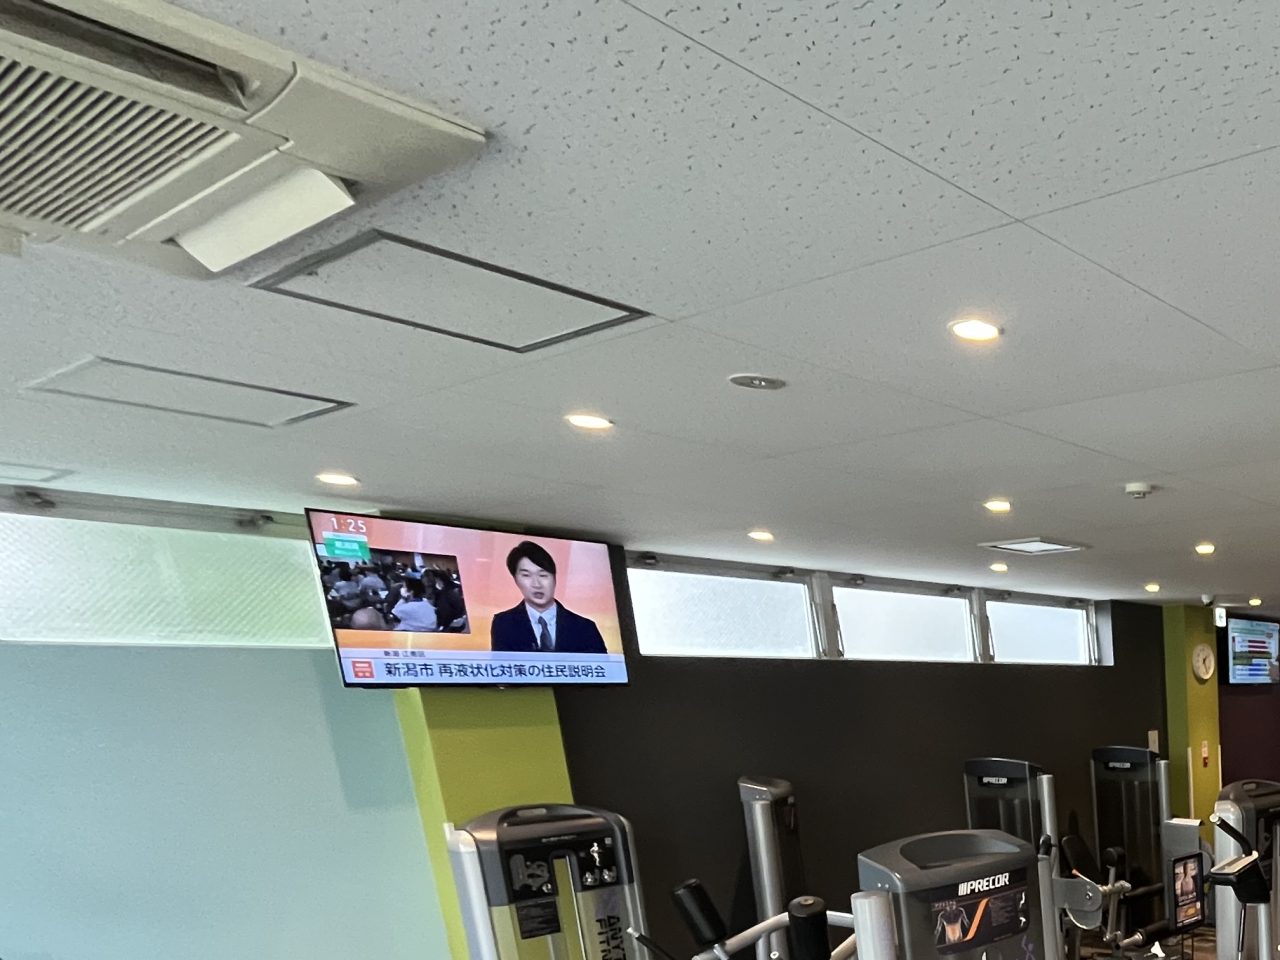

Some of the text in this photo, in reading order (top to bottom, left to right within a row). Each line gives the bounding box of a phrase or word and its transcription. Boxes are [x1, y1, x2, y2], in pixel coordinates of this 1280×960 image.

[330, 517, 367, 533] 1:25
[384, 662, 434, 677] 新潟市
[437, 663, 606, 678] 再液状化対策の住民説明会
[966, 872, 1010, 894] PRECOR
